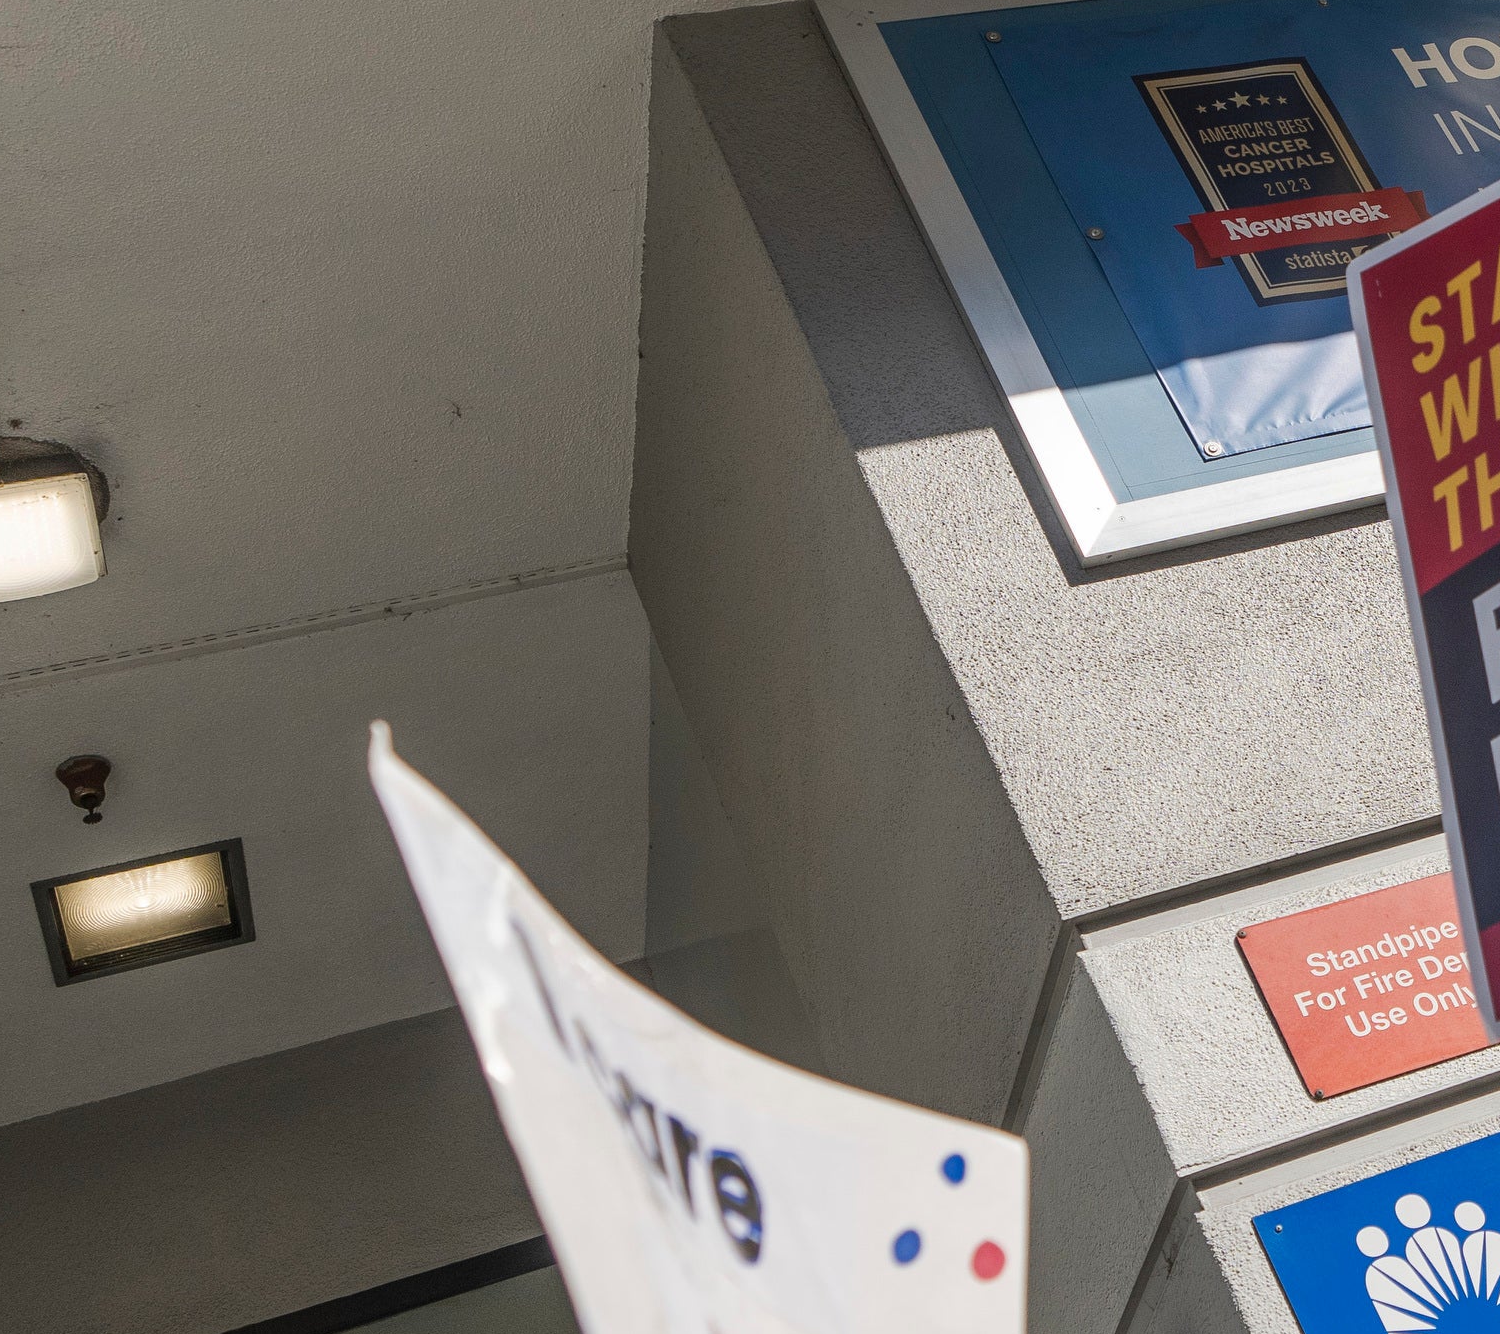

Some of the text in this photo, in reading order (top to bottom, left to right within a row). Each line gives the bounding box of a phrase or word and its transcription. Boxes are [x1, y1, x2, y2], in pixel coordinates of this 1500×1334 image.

[1198, 117, 1315, 145] AMERICA'S BEST
[1224, 138, 1311, 159] CANCER
[1217, 151, 1335, 178] HOSPITALS
[1264, 177, 1312, 198] 2023
[1221, 201, 1389, 241] Newsweek
[1285, 246, 1353, 270] statista
[1306, 920, 1459, 978] Standpipe
[1293, 985, 1347, 1017] For
[1353, 968, 1415, 1000] Fire
[1344, 982, 1478, 1038] Use Only
